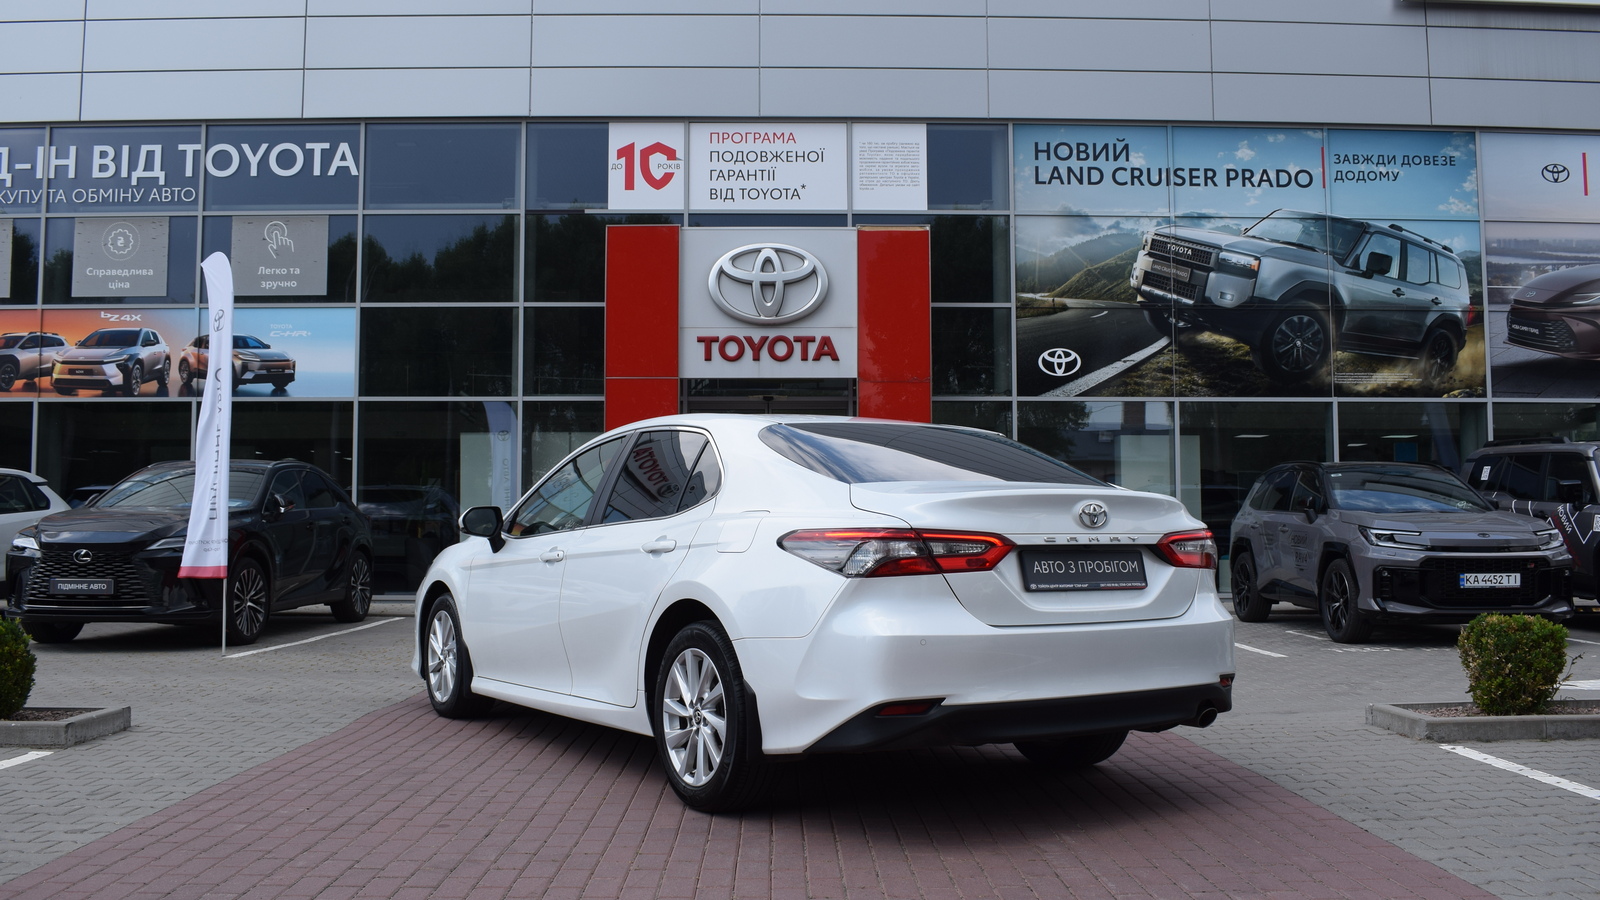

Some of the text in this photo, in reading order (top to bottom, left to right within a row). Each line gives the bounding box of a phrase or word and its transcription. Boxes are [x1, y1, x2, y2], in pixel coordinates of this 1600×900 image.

[709, 131, 797, 145] ПРОГРАМА
[709, 148, 826, 165] ПОДОВЖЕНОЇ
[1034, 138, 1130, 162] НОВИЙ
[92, 144, 166, 186] ВІД
[178, 141, 359, 178] TOYOTA
[611, 163, 623, 171] ДО
[1333, 153, 1456, 168] ЗАВЖДИ ДОВЕЗЕ
[709, 166, 777, 182] ГАРАНТІЇ
[1034, 165, 1314, 189] LAND CRUISER PRADO
[1333, 170, 1400, 184] ДОДОМУ
[48, 189, 67, 203] ТА
[71, 188, 145, 203] ОБМІНУ
[148, 187, 196, 202] АВТО
[709, 187, 735, 203] ВІД
[1167, 244, 1192, 256] TOYOTA
[86, 267, 154, 277] Справедлива
[257, 266, 301, 276] Легко та
[108, 278, 131, 289] ціна
[260, 280, 298, 290] зручно
[696, 335, 840, 362] TOYOTA
[1033, 560, 1065, 574] АВТО
[1078, 560, 1139, 573] ПРОБІГОМ
[1465, 574, 1480, 585] KA
[1481, 574, 1504, 585] 4452
[57, 583, 89, 591] ПІДМІННЕ
